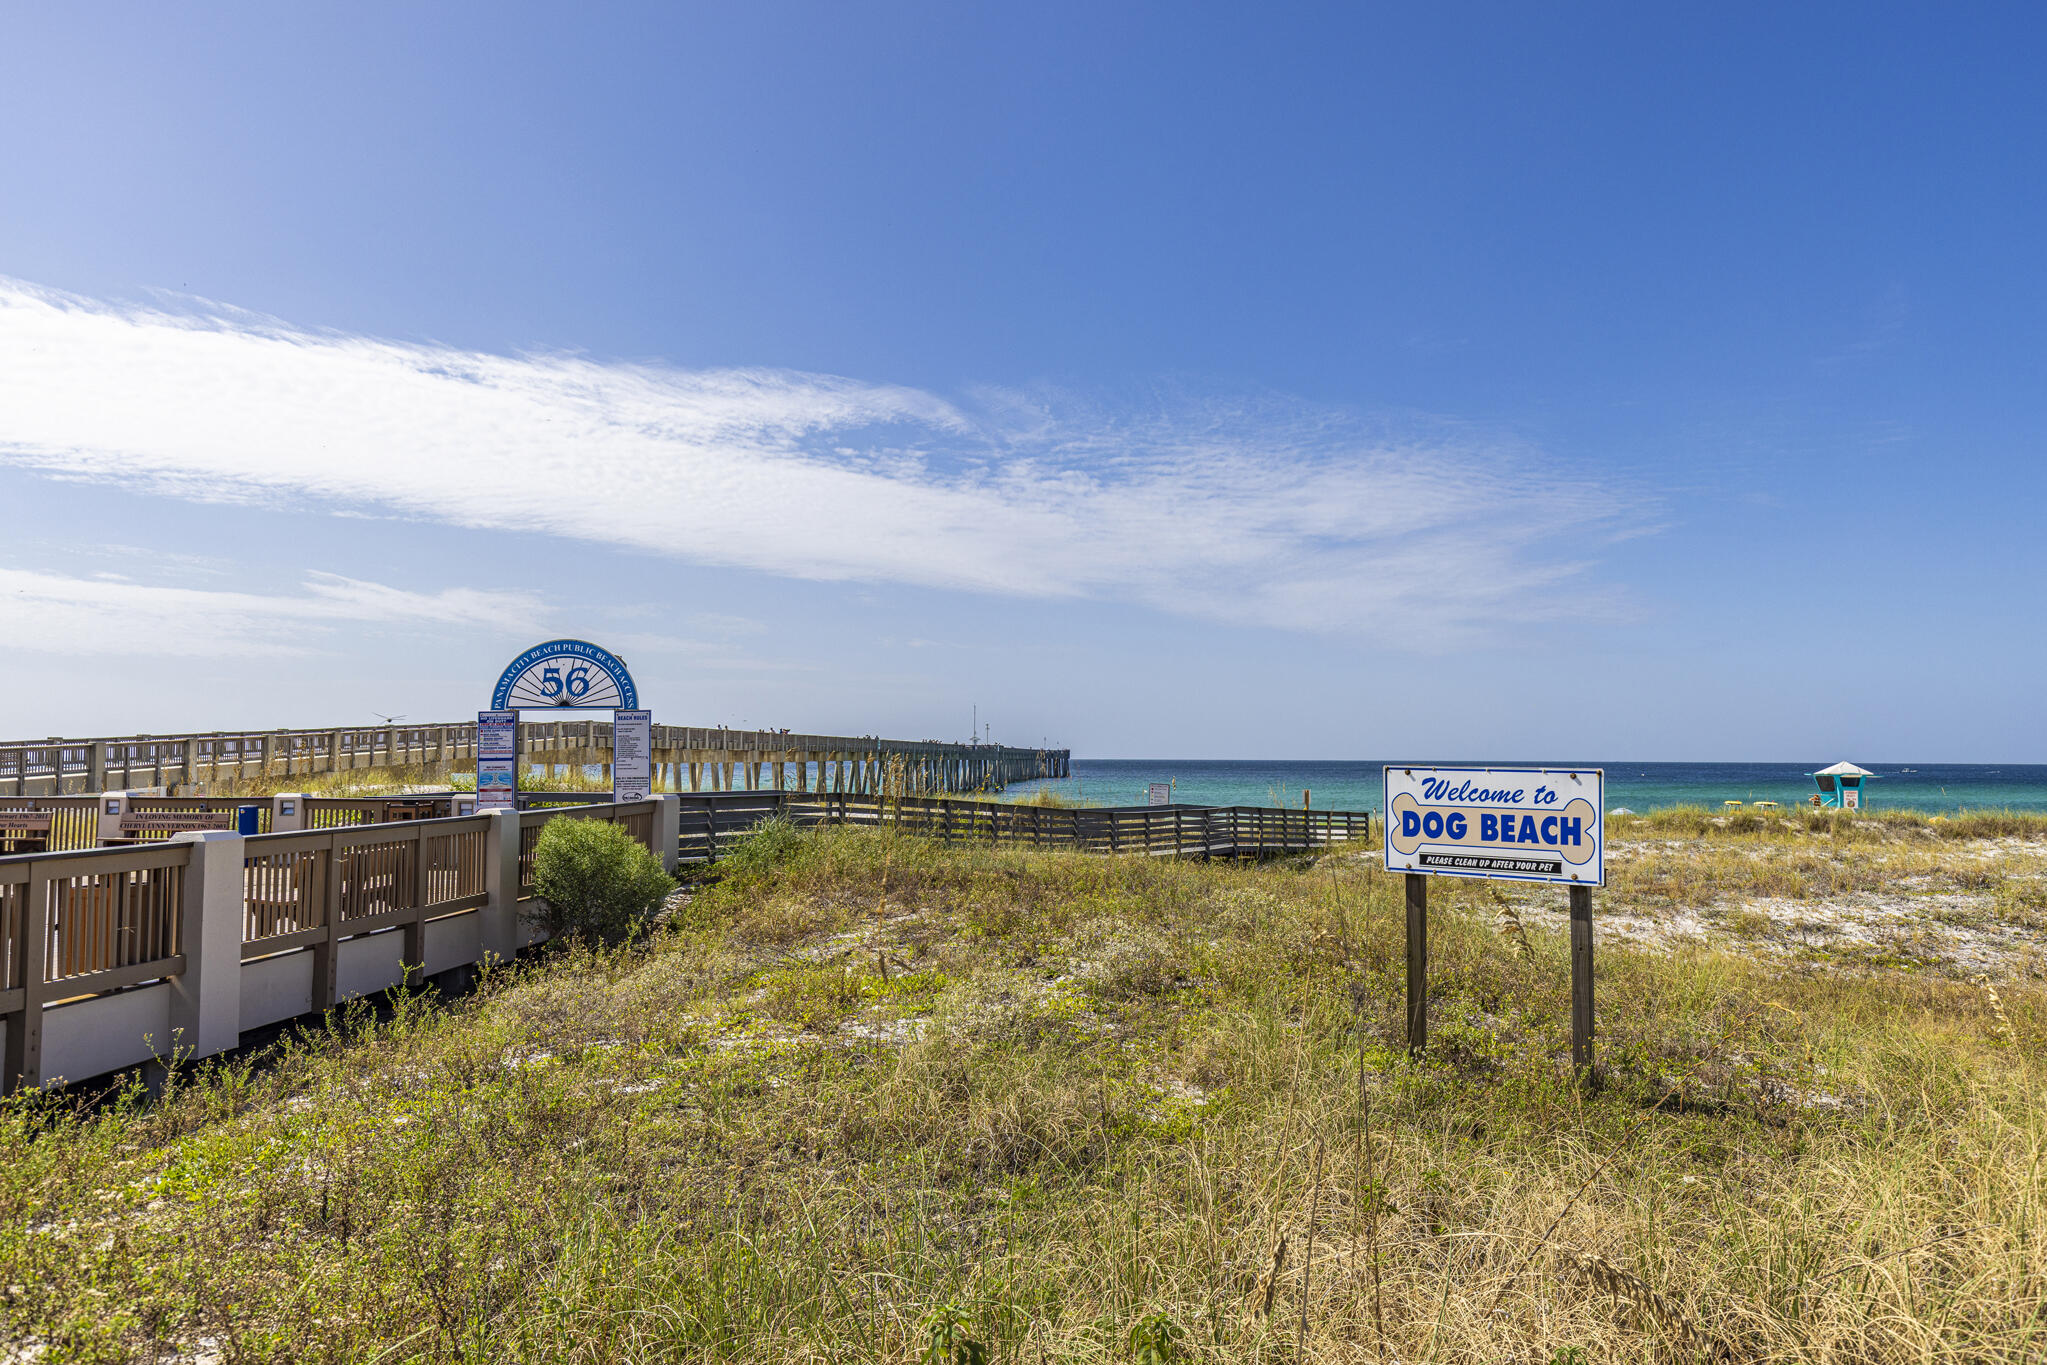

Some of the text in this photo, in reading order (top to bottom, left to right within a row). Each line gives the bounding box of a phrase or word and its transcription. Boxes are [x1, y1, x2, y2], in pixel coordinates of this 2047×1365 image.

[530, 643, 561, 659] BEACH
[562, 643, 597, 656] PUBLIC
[596, 651, 622, 676] BEACH
[620, 675, 635, 709] ACCESS
[540, 667, 590, 697] 56
[1421, 777, 1559, 804] Welcome to
[1402, 810, 1582, 846] DOG BEACH
[1426, 856, 1554, 872] PLEASE CLEAN UP AFTER YOUR PET
